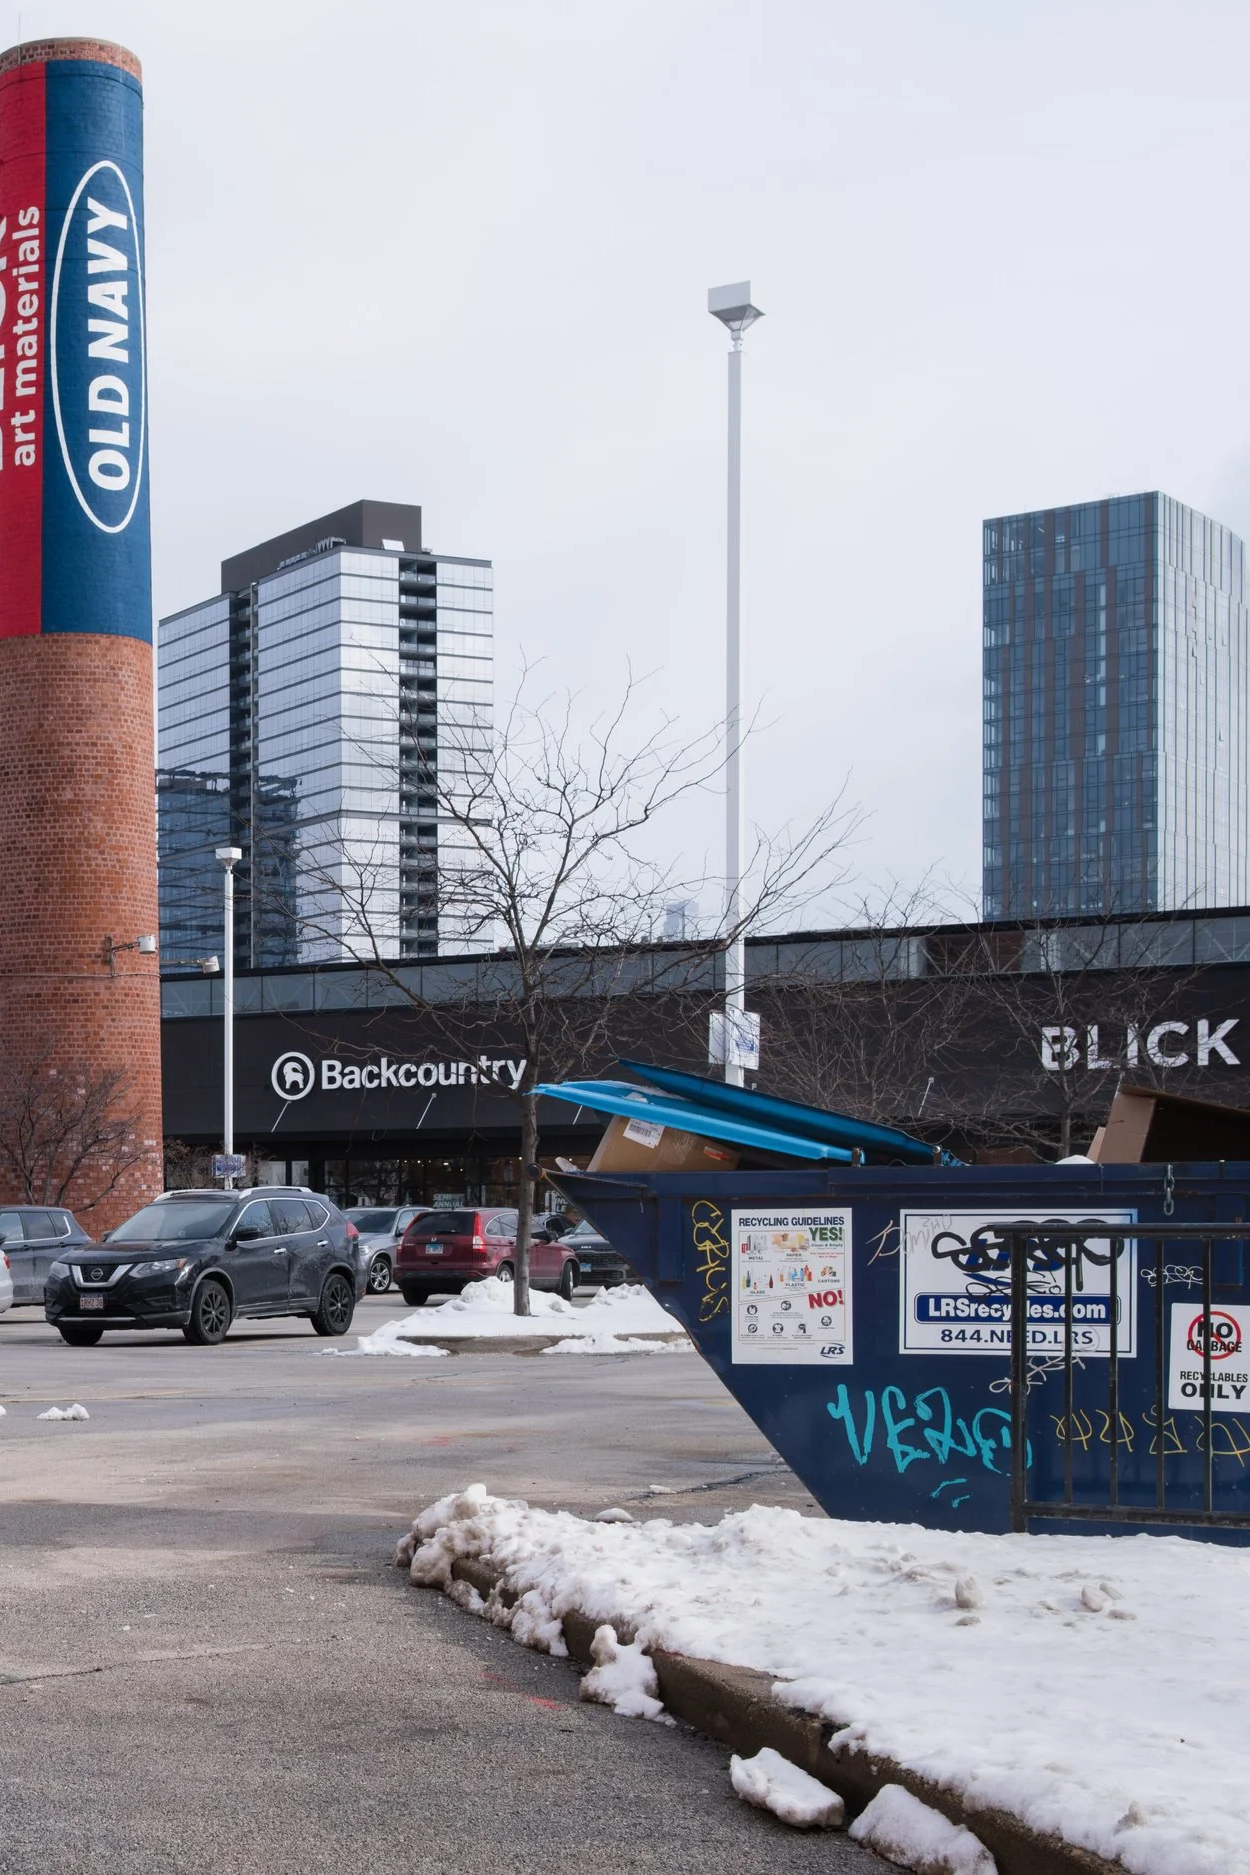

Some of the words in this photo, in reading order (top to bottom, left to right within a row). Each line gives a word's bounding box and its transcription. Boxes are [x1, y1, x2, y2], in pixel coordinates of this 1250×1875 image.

[87, 195, 129, 363] NAVY
[11, 206, 40, 397] materials
[10, 409, 36, 467] art
[88, 374, 131, 491] OLD
[1041, 1018, 1241, 1071] BLICK
[321, 1054, 527, 1090] Backcountry
[738, 1217, 789, 1227] RECYCLING
[791, 1216, 845, 1226] GUIDELINES
[809, 1227, 843, 1241] YES!
[808, 1289, 845, 1309] NO!
[928, 1297, 1107, 1321] LRSrecyles.com
[1197, 1322, 1234, 1339] NO
[820, 1346, 846, 1355] LRS
[1186, 1339, 1243, 1353] GABAGE
[1180, 1382, 1247, 1400] ONLY
